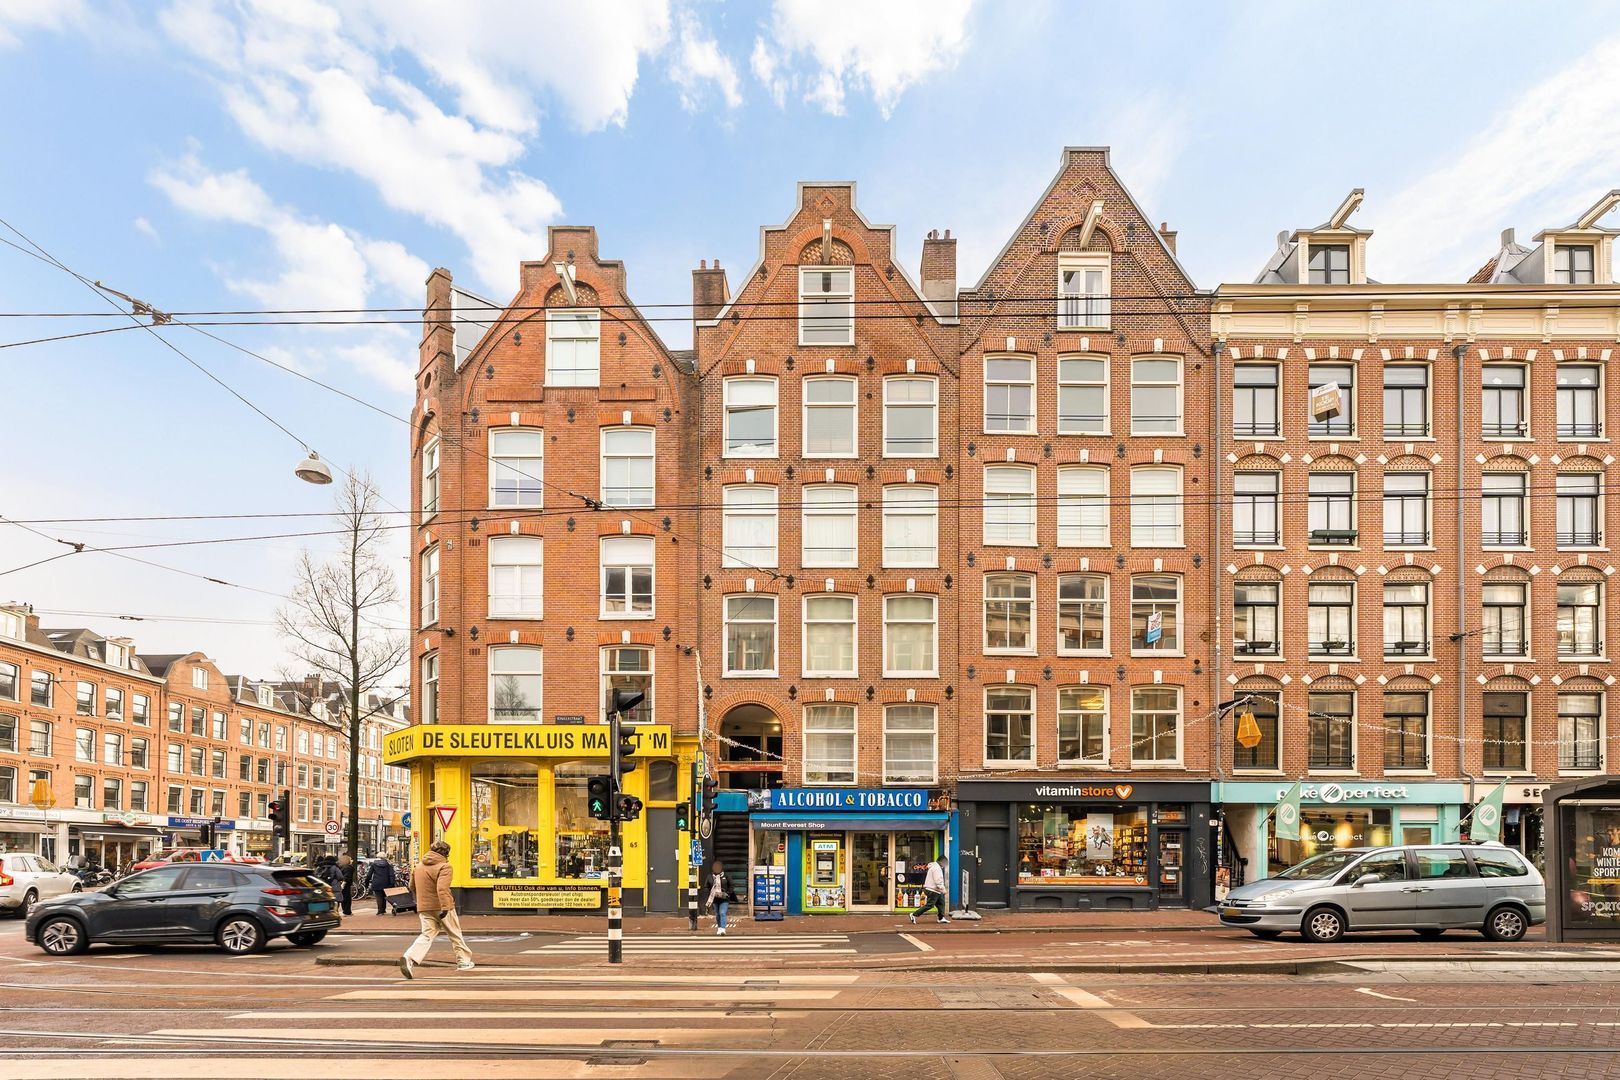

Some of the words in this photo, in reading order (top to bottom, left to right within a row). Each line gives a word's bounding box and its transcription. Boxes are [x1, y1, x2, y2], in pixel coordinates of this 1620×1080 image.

[389, 734, 414, 756] SLOTEN
[423, 732, 444, 748] DE
[450, 732, 574, 749] SLEUTELKLUIS
[582, 732, 643, 749] MAKT
[649, 732, 667, 749] 'M
[1035, 785, 1114, 797] vitaminstore
[1276, 785, 1318, 800] pké
[1343, 786, 1409, 800] perfect
[778, 792, 843, 806] ALCOHOL
[845, 794, 855, 805] &
[858, 792, 922, 806] TOBACCO
